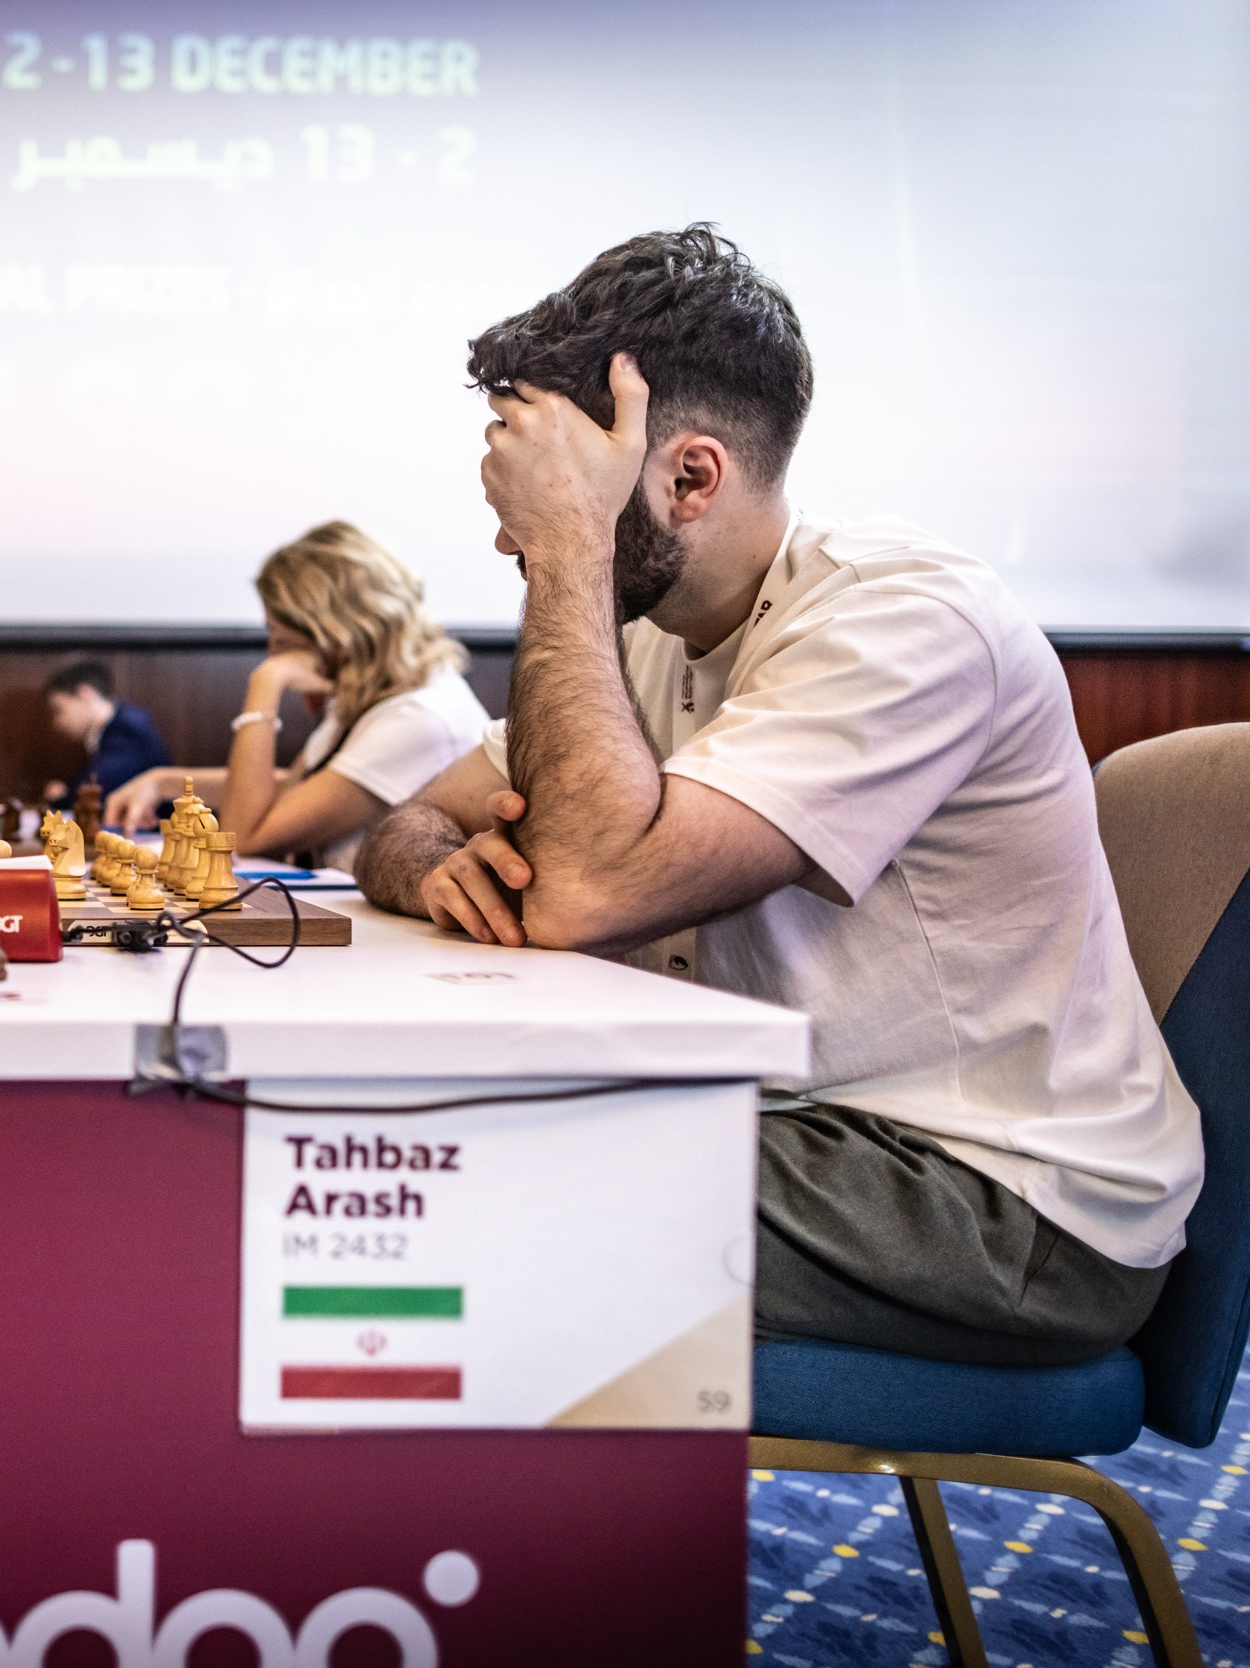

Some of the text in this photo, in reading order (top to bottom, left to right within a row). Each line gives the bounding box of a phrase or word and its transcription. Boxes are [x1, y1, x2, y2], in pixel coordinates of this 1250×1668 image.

[171, 34, 479, 98] DECEMBER
[11, 135, 275, 192] ديسمبر
[302, 124, 375, 183] 13
[438, 125, 477, 184] 2
[65, 263, 231, 314] PRIZES
[285, 1135, 460, 1171] Tahbaz
[285, 1184, 424, 1218] Arash
[283, 1233, 408, 1259] IM 2432
[697, 1391, 731, 1413] 59
